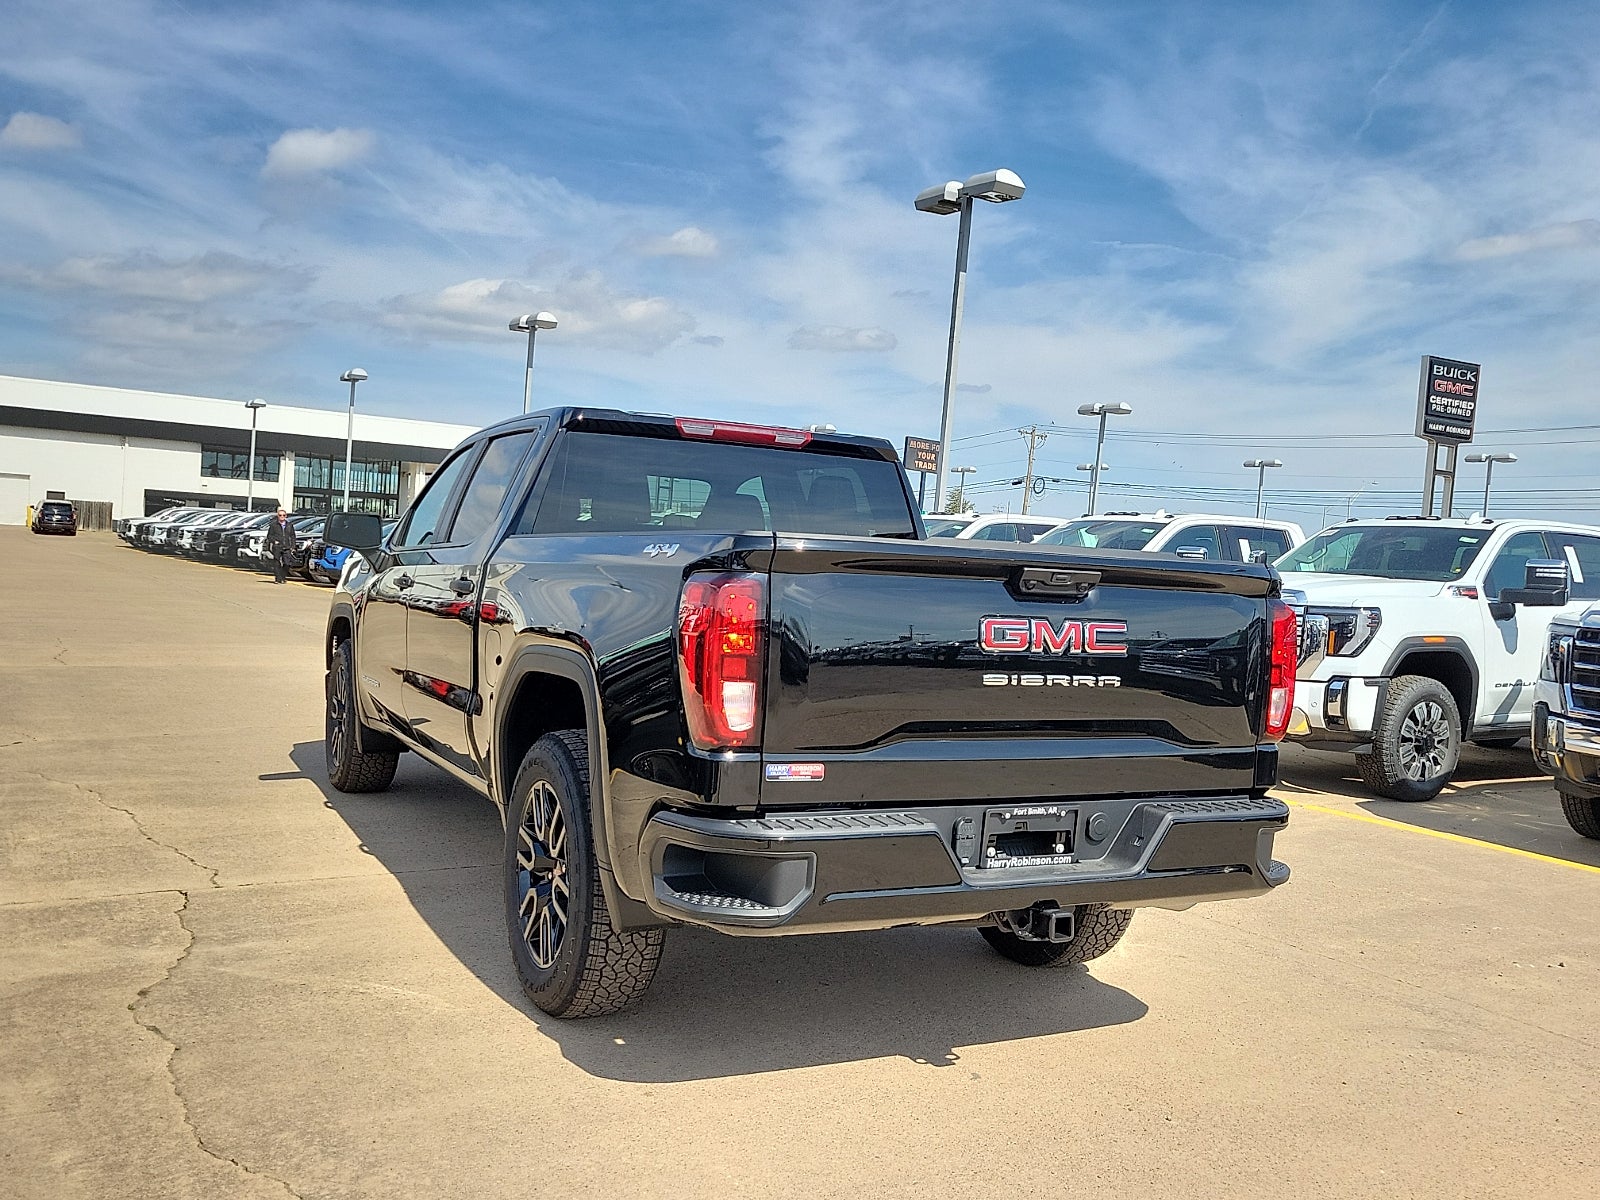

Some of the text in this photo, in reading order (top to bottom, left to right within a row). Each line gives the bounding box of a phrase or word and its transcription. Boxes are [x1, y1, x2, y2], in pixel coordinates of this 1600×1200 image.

[1433, 364, 1476, 382] BUICK
[1434, 379, 1475, 397] GMC
[1430, 395, 1475, 410] CERTIFIED
[1431, 404, 1471, 417] PRE-OWNED
[1428, 422, 1445, 432] HARRY
[910, 440, 940, 452] MORE FO
[917, 451, 936, 461] YOUR
[914, 460, 937, 471] TRADE
[977, 614, 1128, 657] GMC
[982, 673, 1122, 688] SIERRA
[1013, 807, 1027, 816] Fort
[987, 855, 1072, 869] HarryRobinson.com
